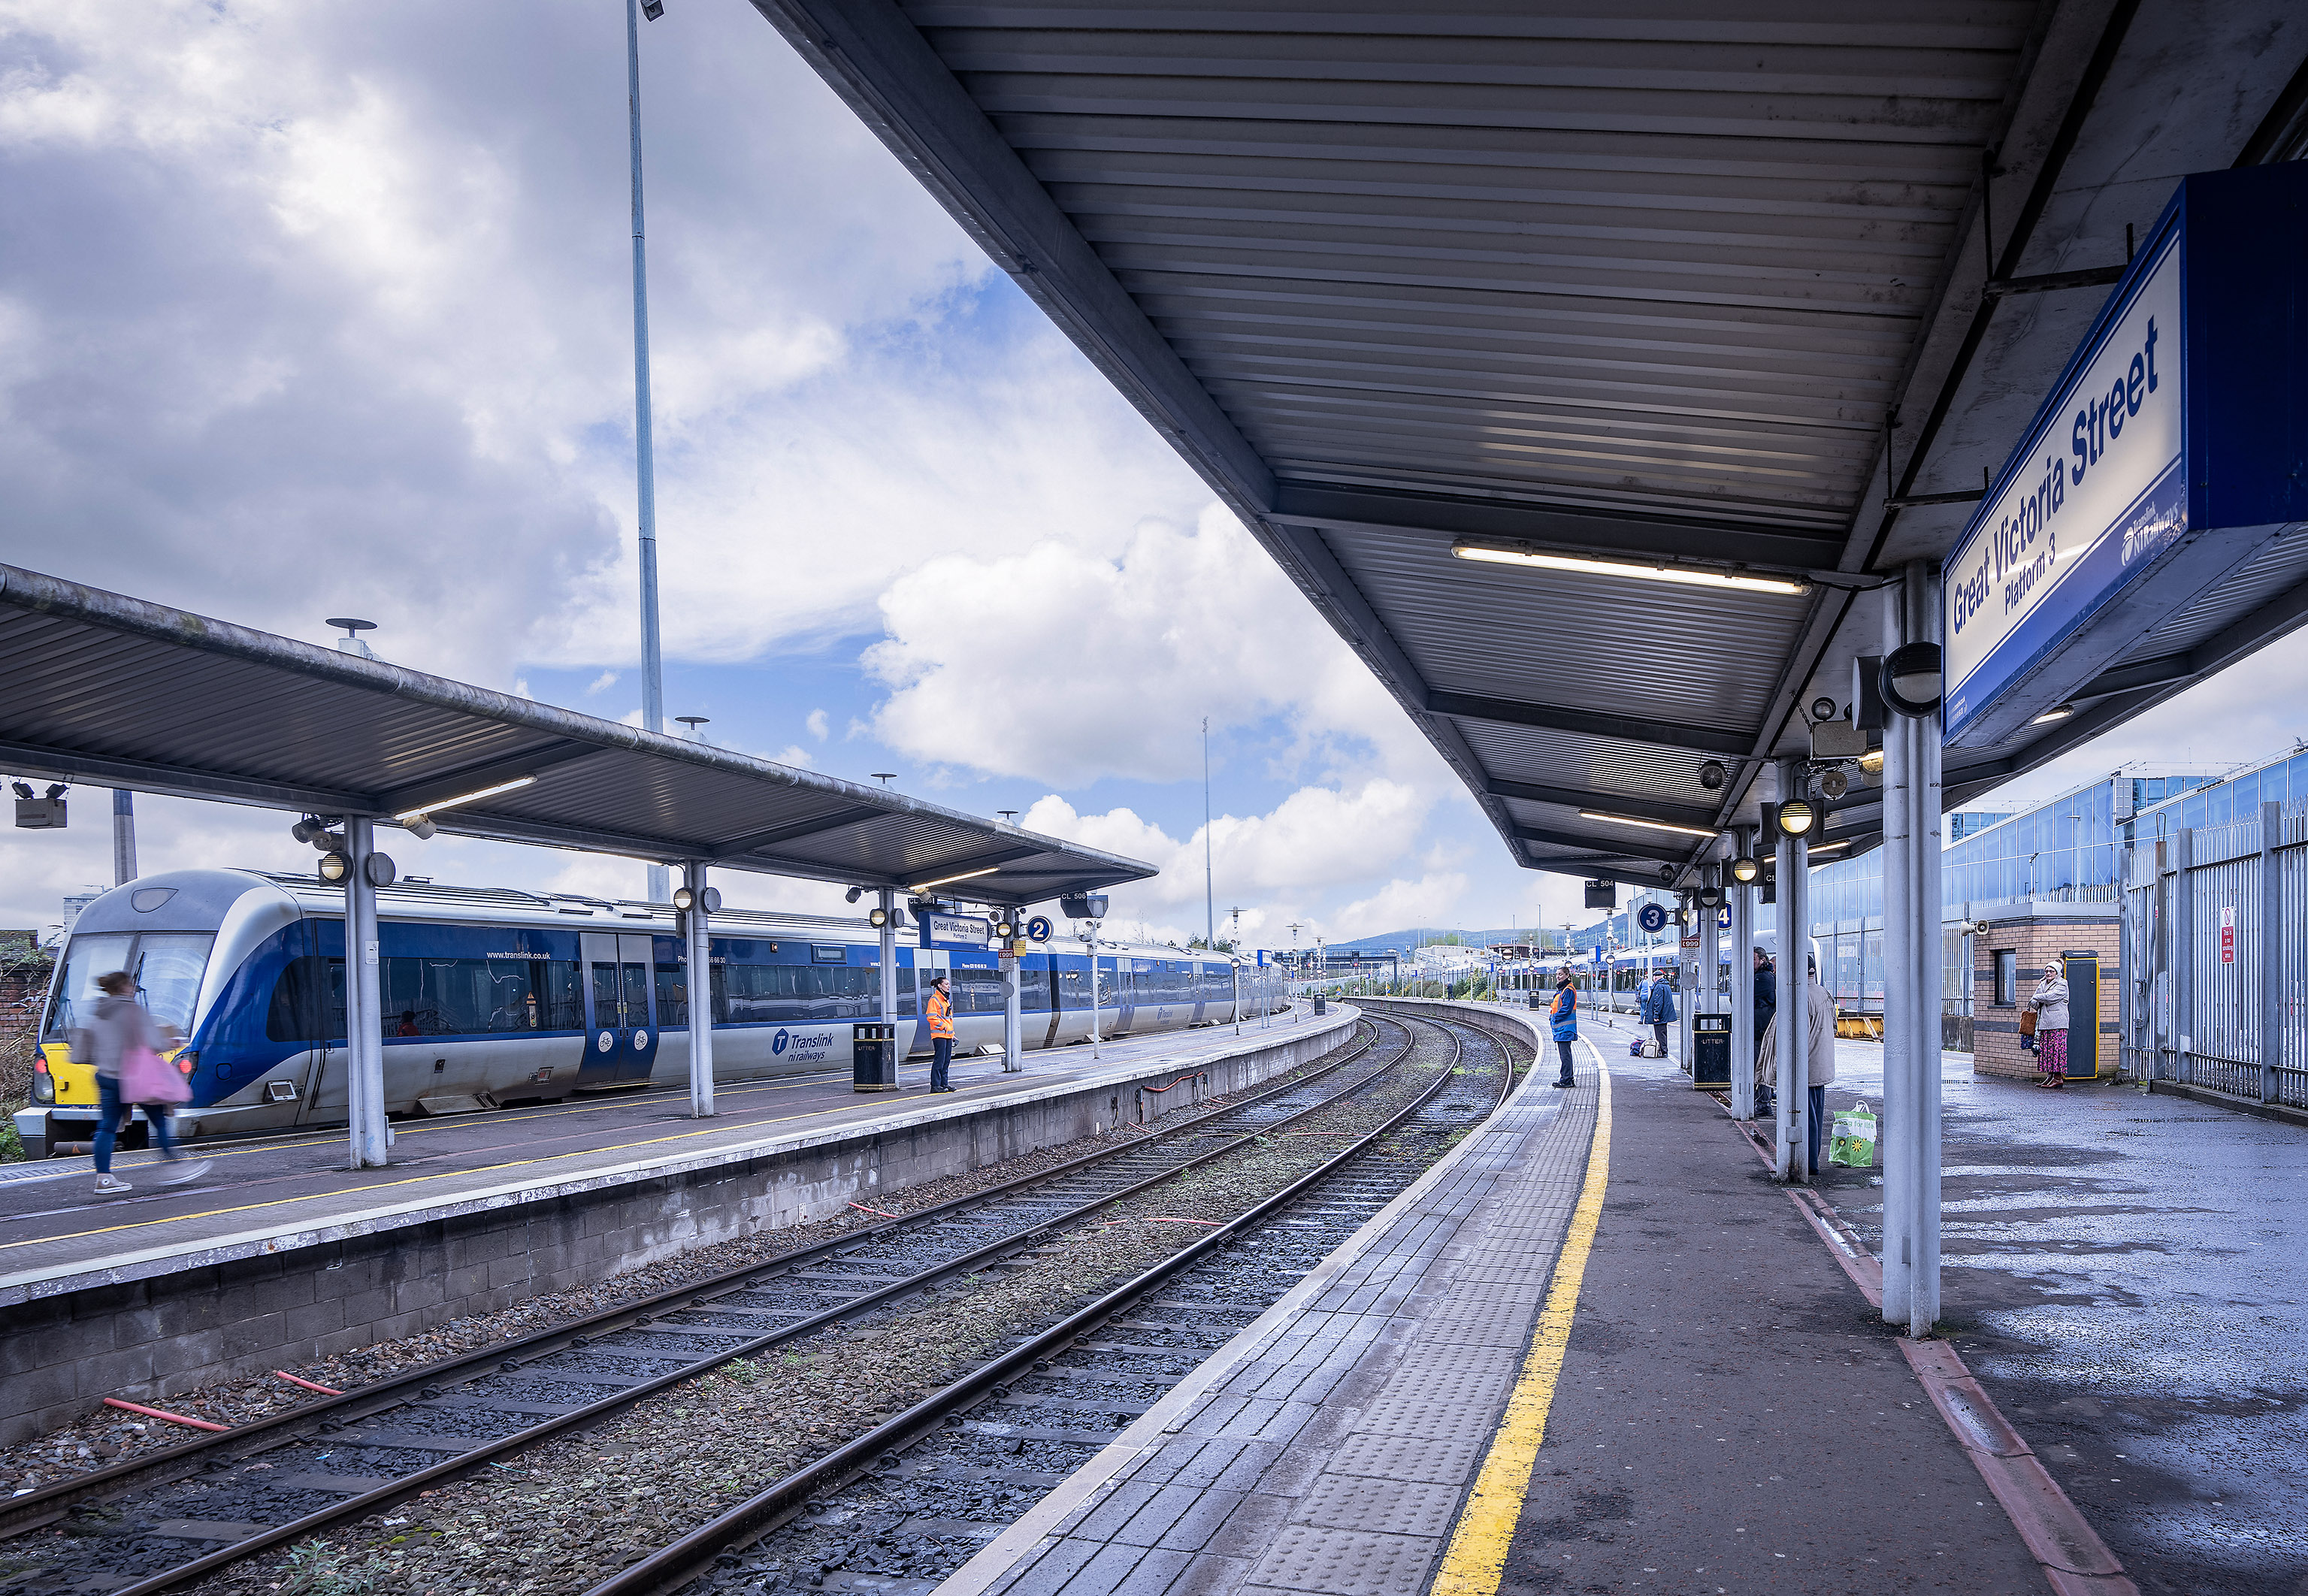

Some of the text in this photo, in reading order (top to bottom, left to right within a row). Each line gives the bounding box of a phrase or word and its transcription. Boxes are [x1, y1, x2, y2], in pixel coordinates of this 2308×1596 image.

[1954, 314, 2158, 635] Great Victoria Street
[2004, 531, 2056, 616] Platform 3
[1646, 909, 1660, 927] 3
[1718, 906, 1730, 924] 4
[933, 920, 985, 935] Great Victoria Street
[1033, 921, 1045, 938] 2
[486, 951, 551, 960] www.translink.co.uk
[791, 1032, 834, 1050] Translink
[788, 1050, 825, 1062] ni railways
[1864, 1121, 1874, 1129] life
